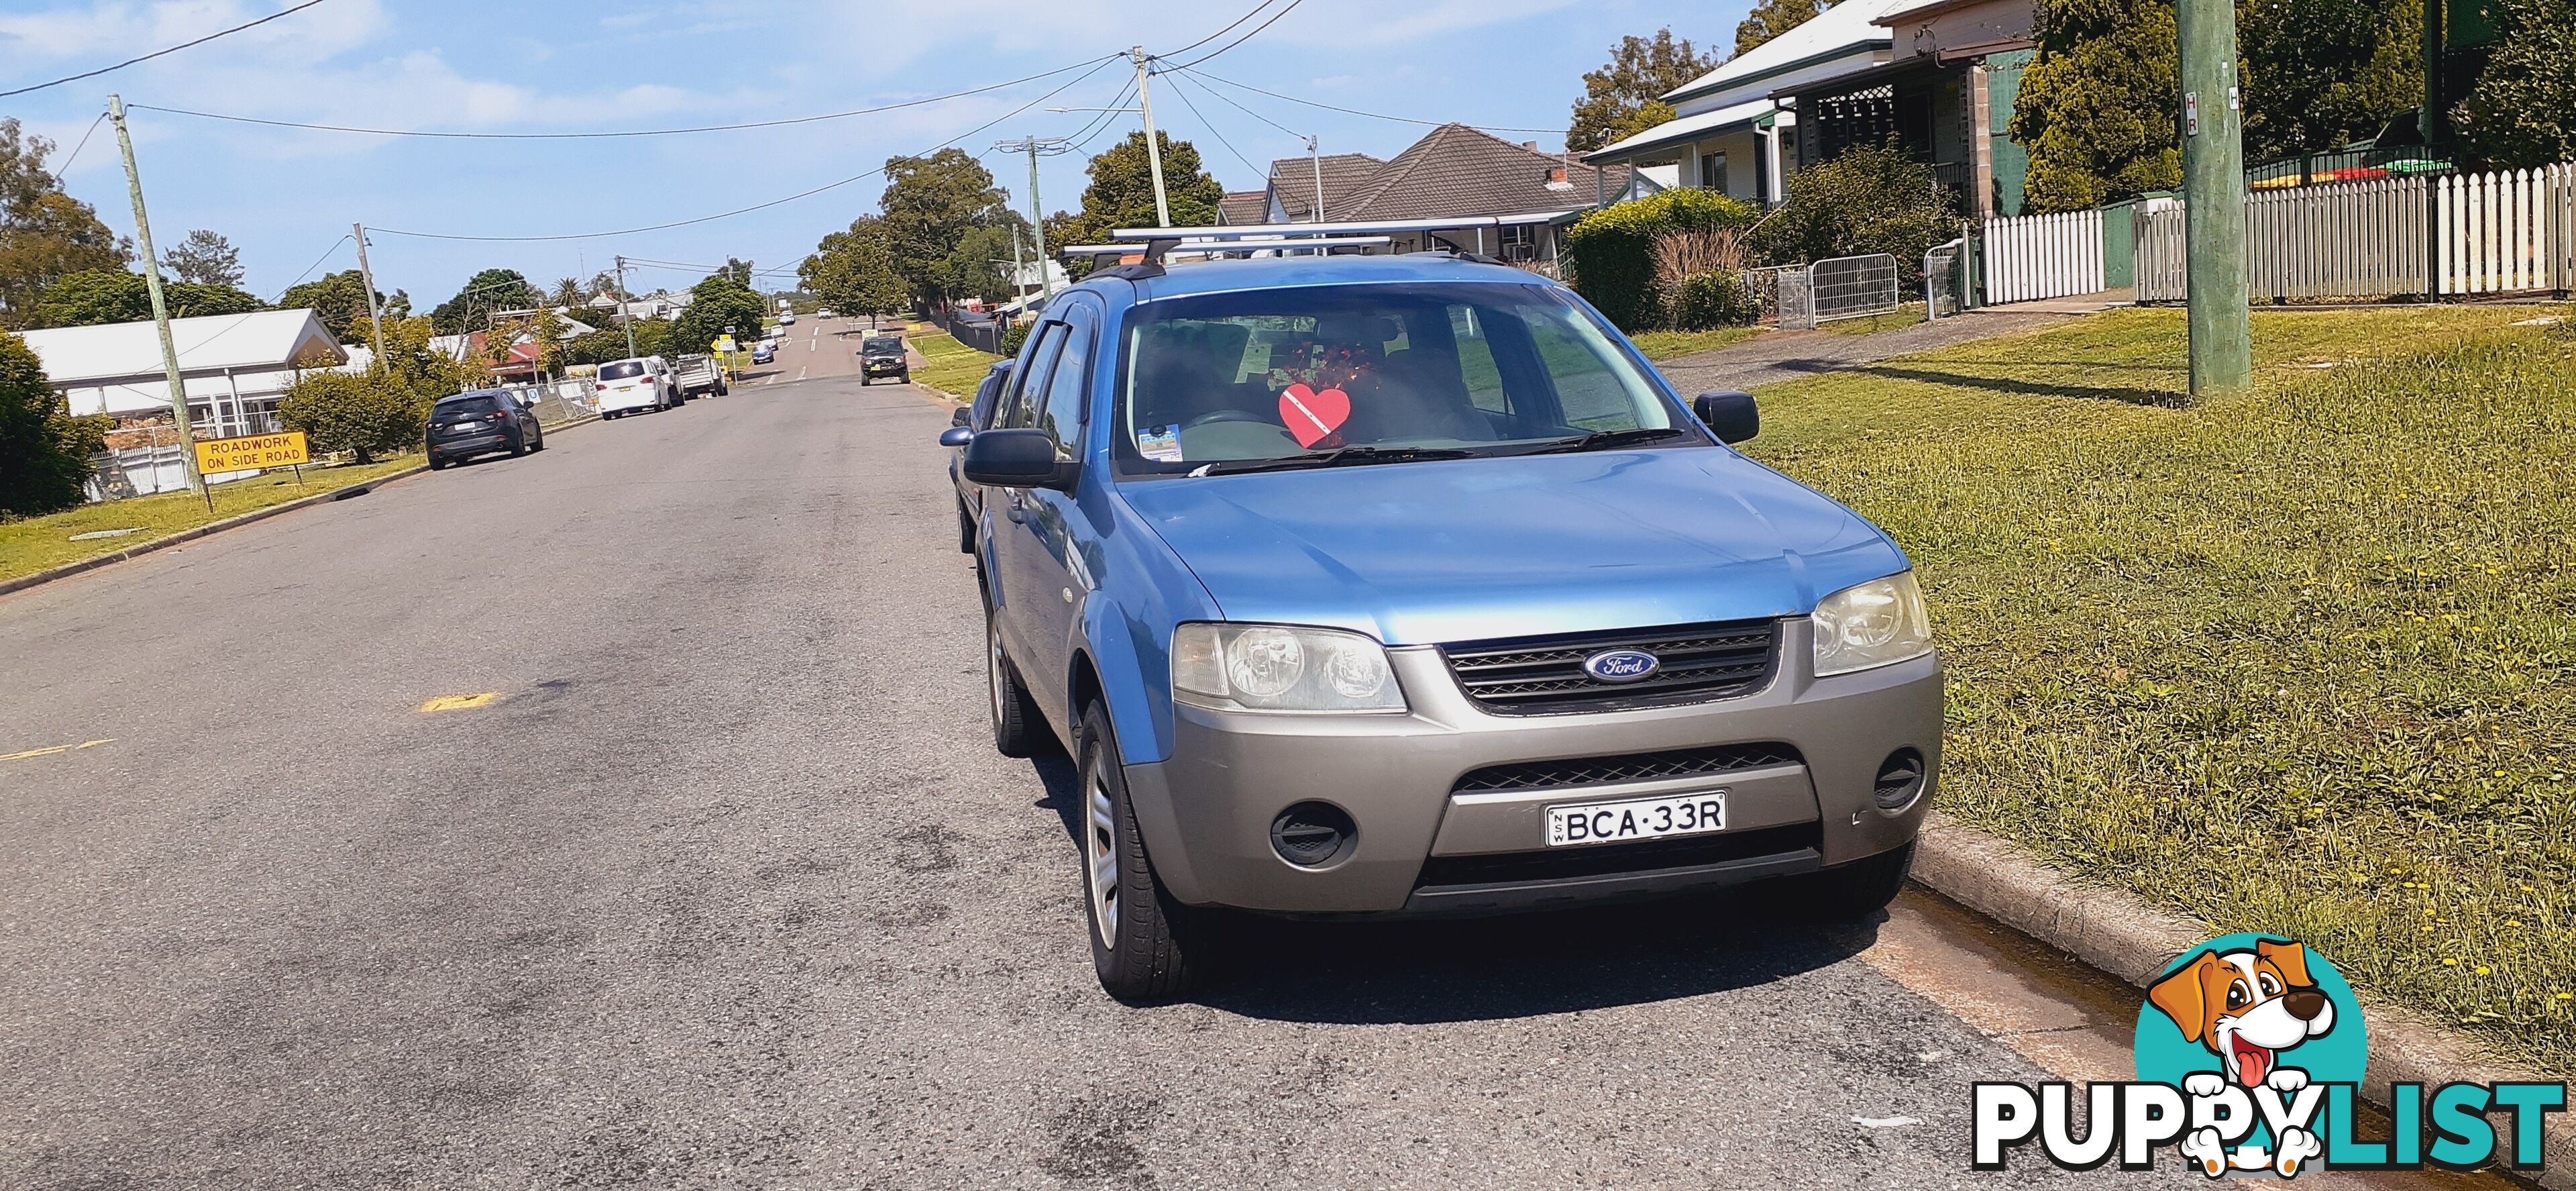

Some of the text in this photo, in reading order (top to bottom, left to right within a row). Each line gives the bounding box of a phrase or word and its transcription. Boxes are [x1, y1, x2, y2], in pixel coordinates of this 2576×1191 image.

[211, 436, 292, 454] ROADWORK
[207, 450, 300, 469] ON SIDE ROAD
[1603, 657, 1643, 674] Ford
